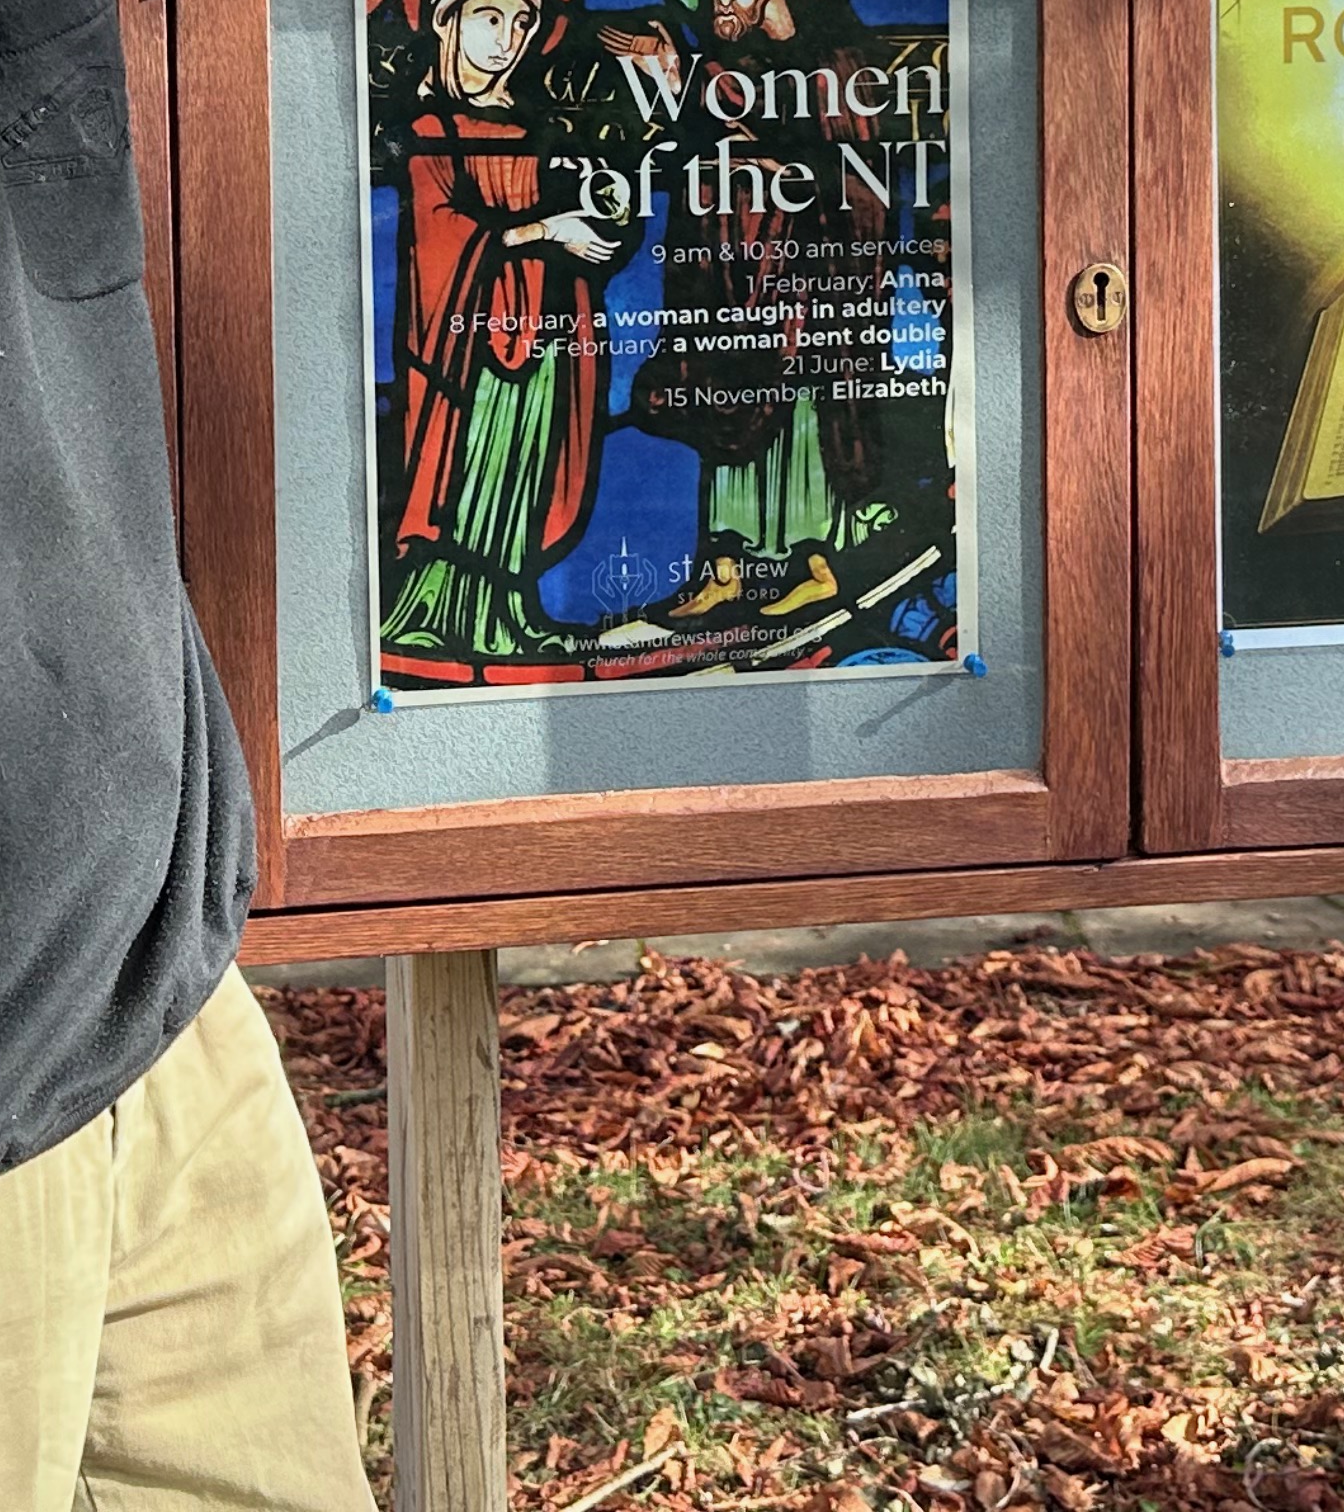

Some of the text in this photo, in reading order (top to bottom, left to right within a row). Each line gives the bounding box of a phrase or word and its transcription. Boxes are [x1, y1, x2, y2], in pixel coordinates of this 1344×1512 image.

[616, 53, 944, 123] Women
[580, 139, 946, 219] of the NT
[651, 235, 945, 264] 9 am & 10.30 am services
[746, 271, 945, 295] 1 February: Anna
[449, 297, 946, 335] 8 February: a woman caught in adultery
[524, 323, 946, 359] 15 February: a woman bent double
[782, 352, 946, 376] 21 June: Lydia
[664, 377, 947, 407] 15 November: Elizabeth
[668, 554, 693, 583] St
[587, 654, 635, 669] church
[637, 652, 659, 666] for
[661, 651, 683, 665] the
[686, 649, 726, 663] whole
